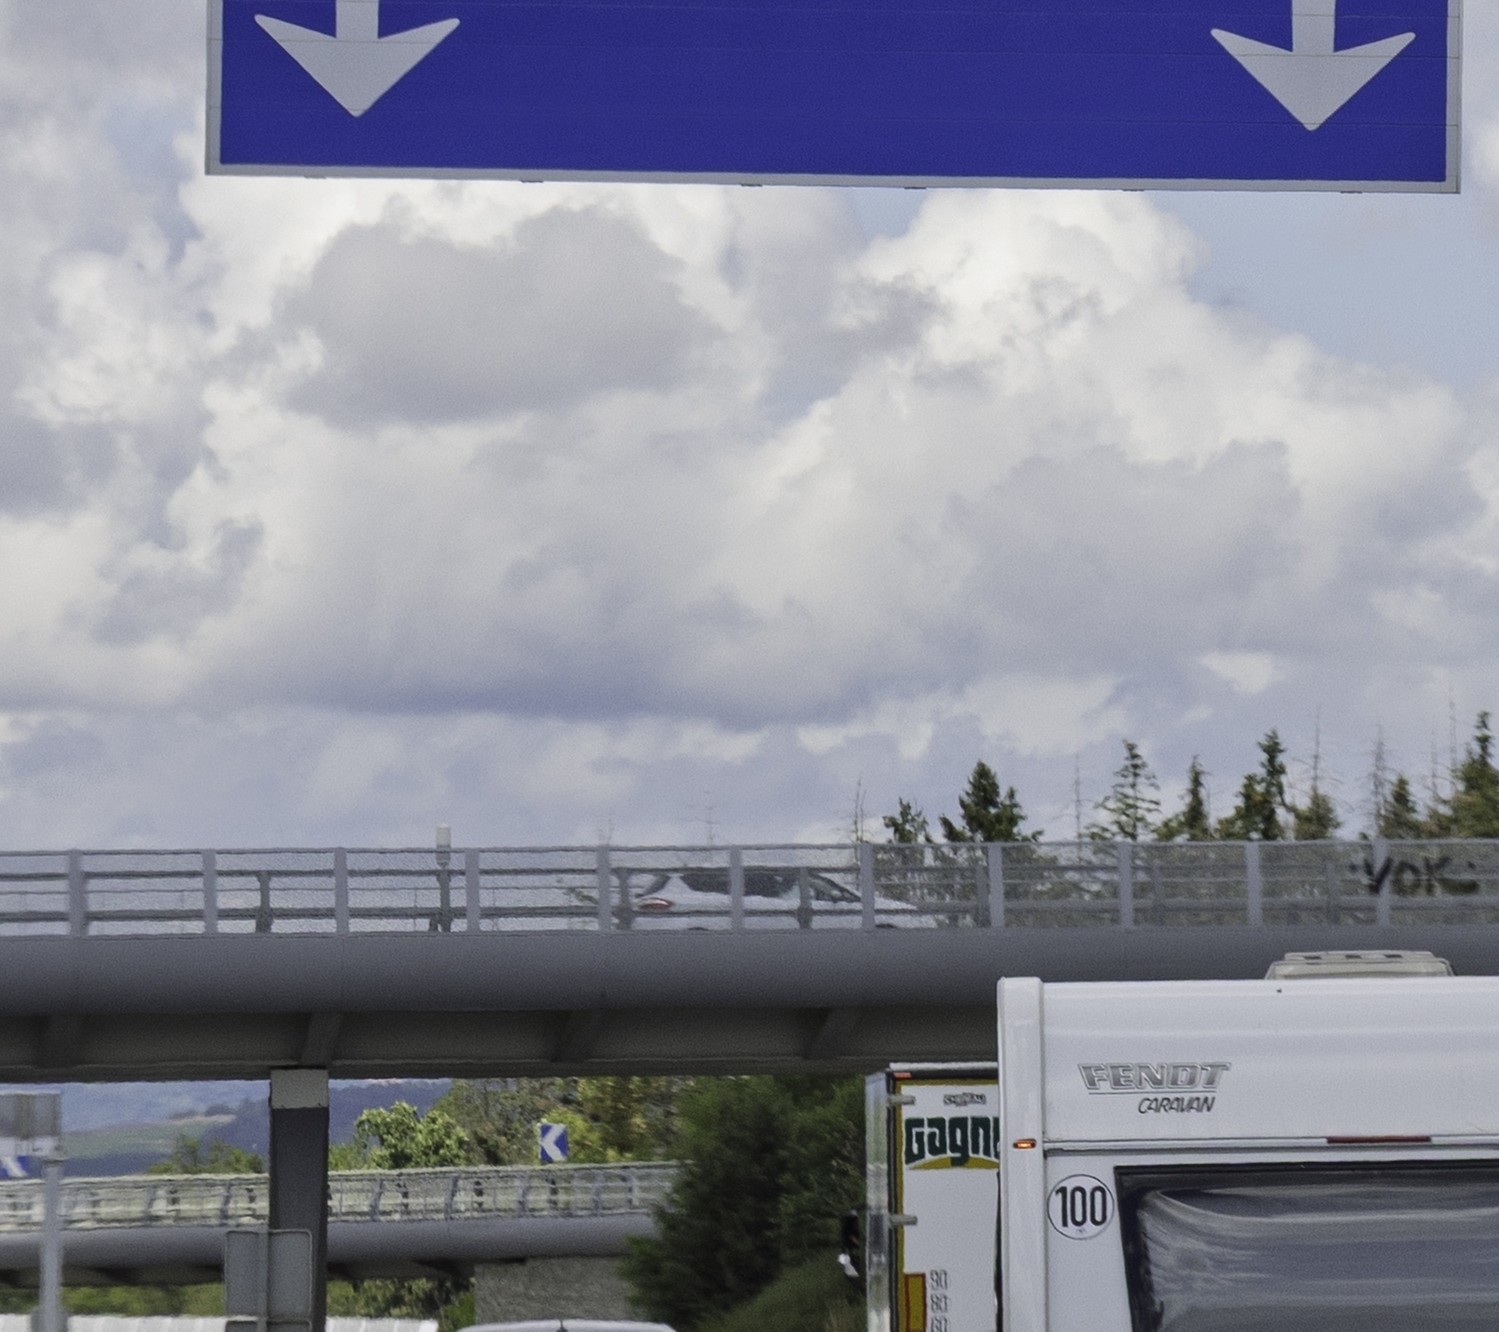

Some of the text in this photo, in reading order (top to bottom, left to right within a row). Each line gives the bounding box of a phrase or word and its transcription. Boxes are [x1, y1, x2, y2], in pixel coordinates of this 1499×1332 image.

[1077, 1061, 1233, 1090] FENDT
[1137, 1096, 1216, 1114] CARAVAN
[1055, 1185, 1108, 1228] 100
